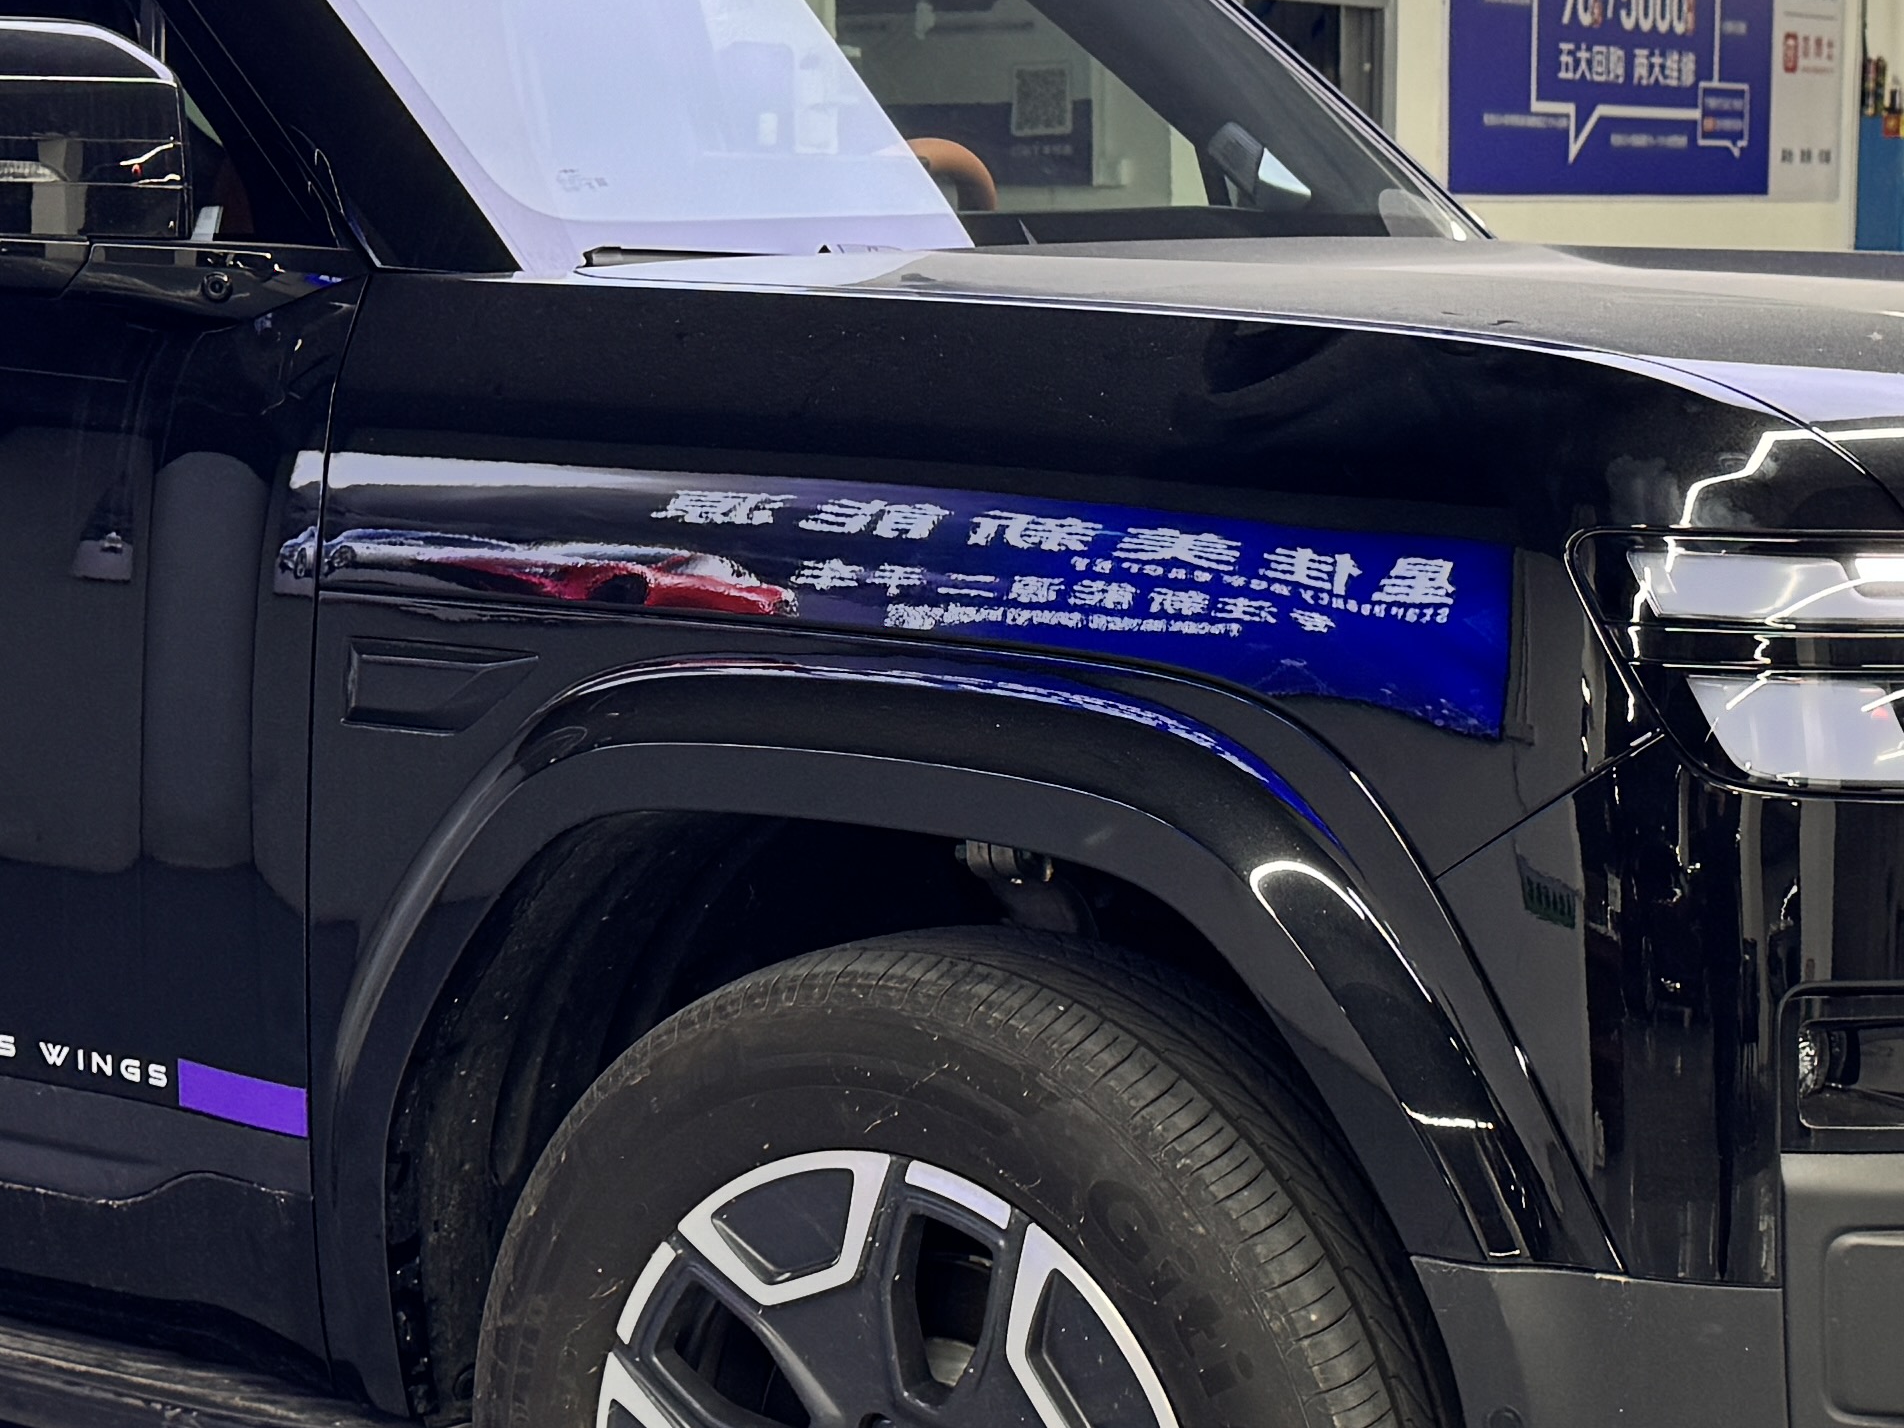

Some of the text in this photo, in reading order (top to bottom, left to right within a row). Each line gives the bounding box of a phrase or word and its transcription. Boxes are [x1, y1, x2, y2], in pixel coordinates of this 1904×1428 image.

[1558, 41, 1626, 85] 五大回购
[38, 1040, 169, 1089] WINGS
